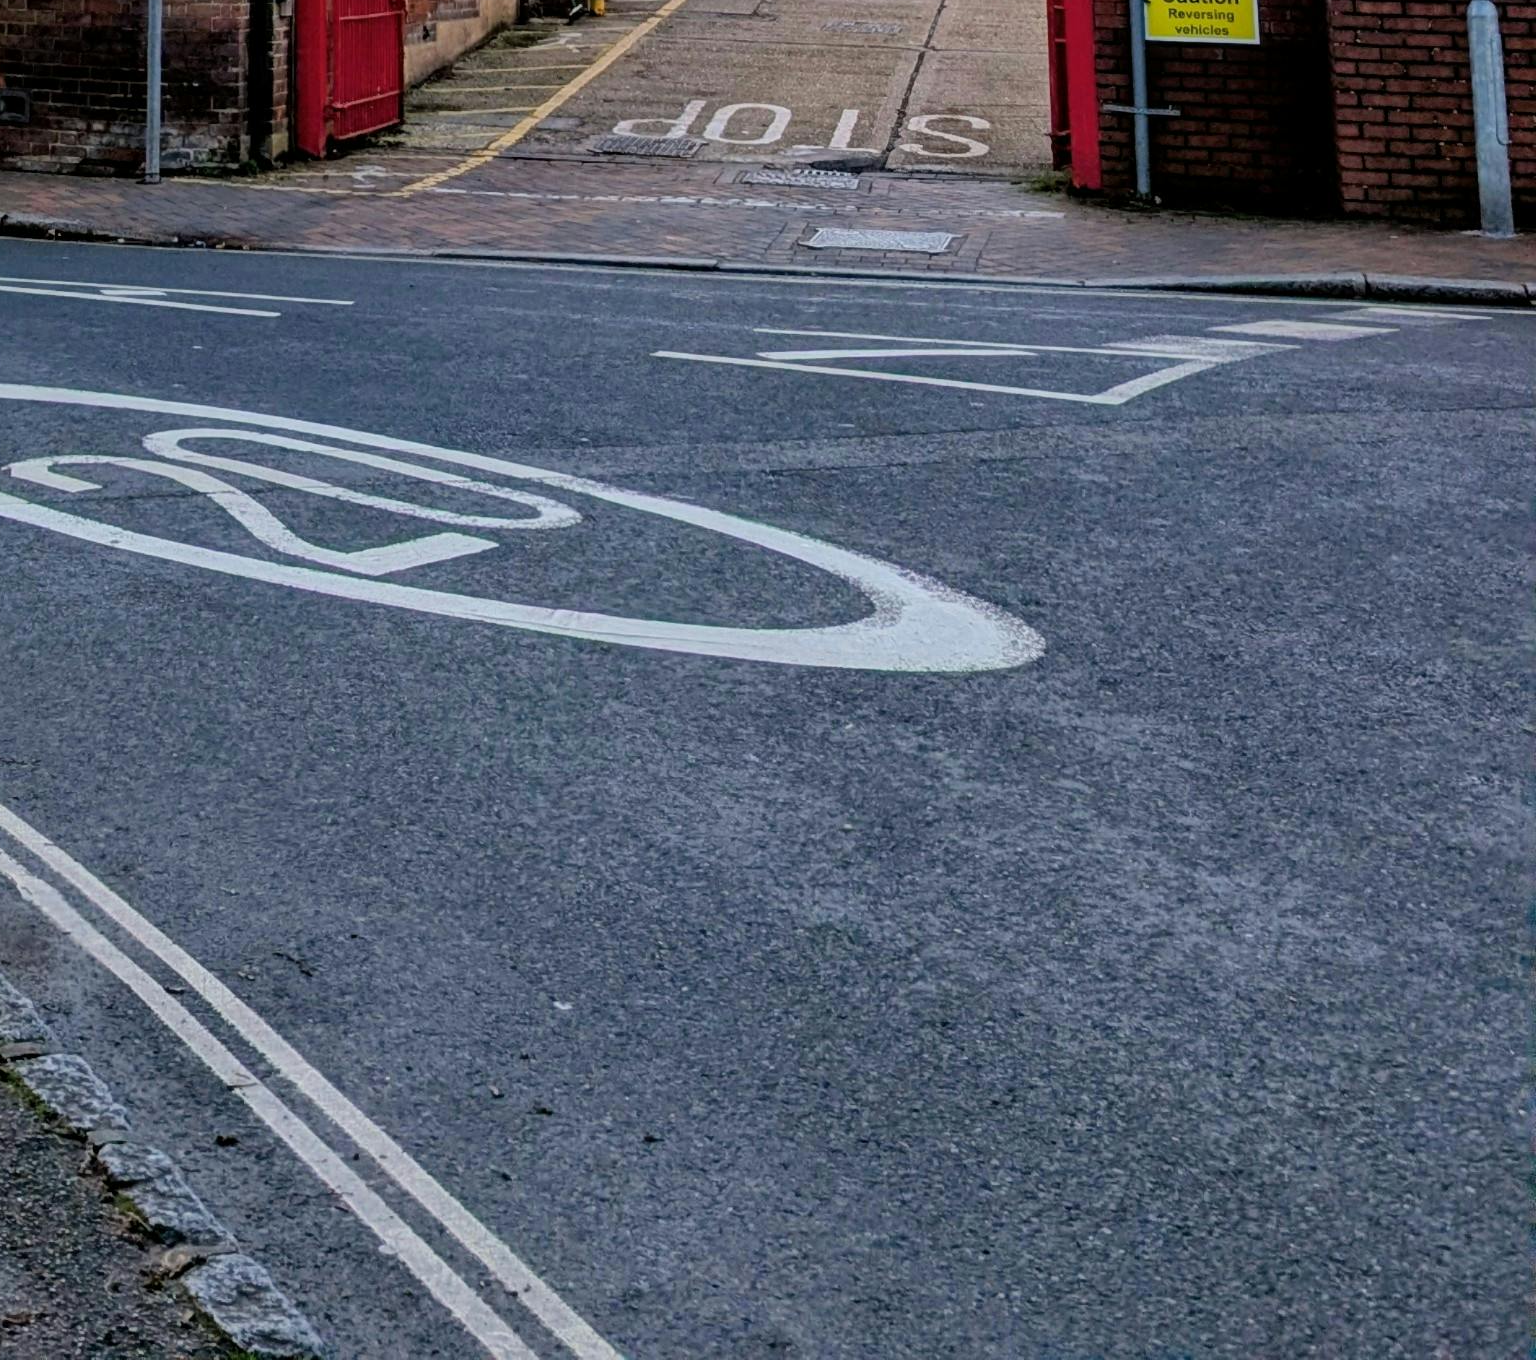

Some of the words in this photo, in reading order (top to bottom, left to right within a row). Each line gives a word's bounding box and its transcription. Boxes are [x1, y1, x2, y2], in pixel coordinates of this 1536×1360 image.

[1168, 8, 1235, 23] Reversing
[1175, 24, 1229, 36] vehicles
[612, 99, 991, 158] STOP
[9, 427, 584, 577] 20
